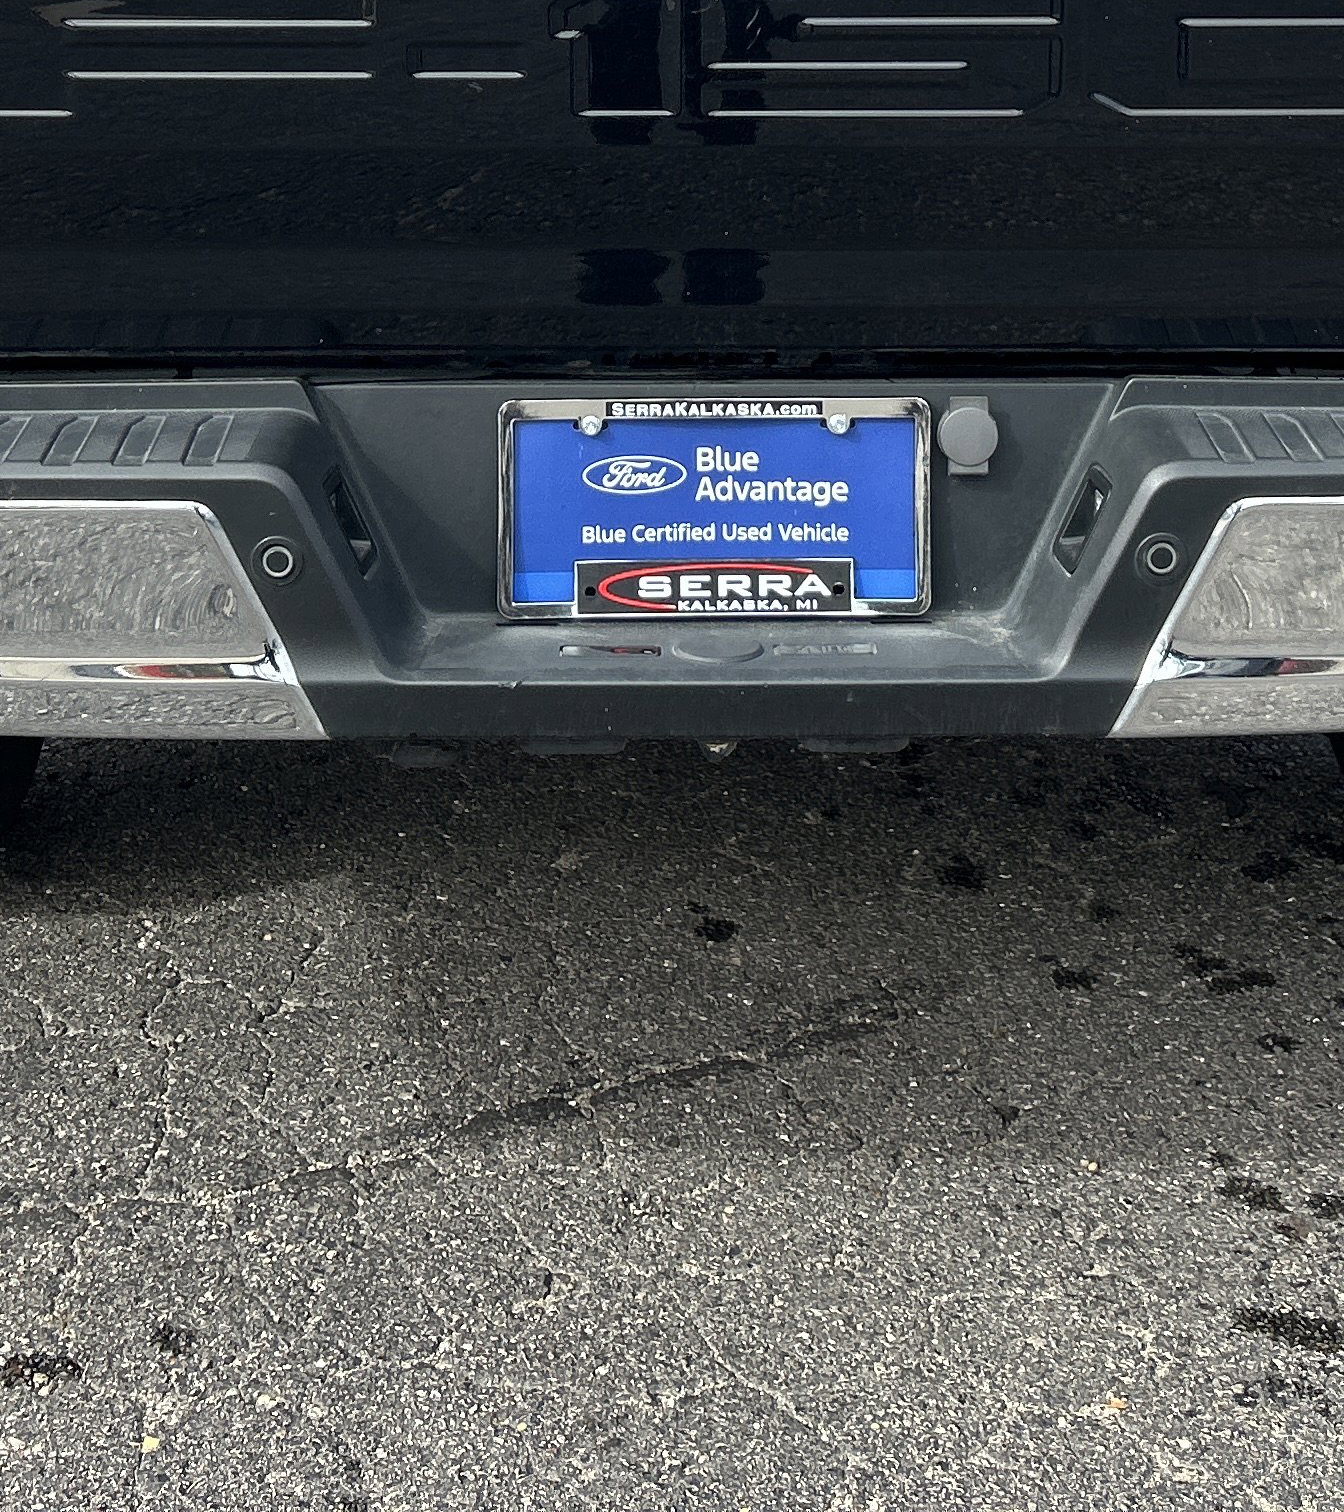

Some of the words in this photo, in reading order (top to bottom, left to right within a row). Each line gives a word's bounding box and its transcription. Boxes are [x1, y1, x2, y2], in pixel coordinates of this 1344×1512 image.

[695, 446, 760, 472] Blue
[602, 460, 667, 488] Ford
[695, 476, 849, 507] Advantage
[581, 525, 626, 544] Blue
[632, 523, 716, 543] Certified
[722, 522, 772, 542] Used
[778, 522, 850, 542] Vehicle
[637, 574, 832, 598] SERRA
[677, 599, 789, 612] KALKASKA,
[796, 599, 818, 610] MI
